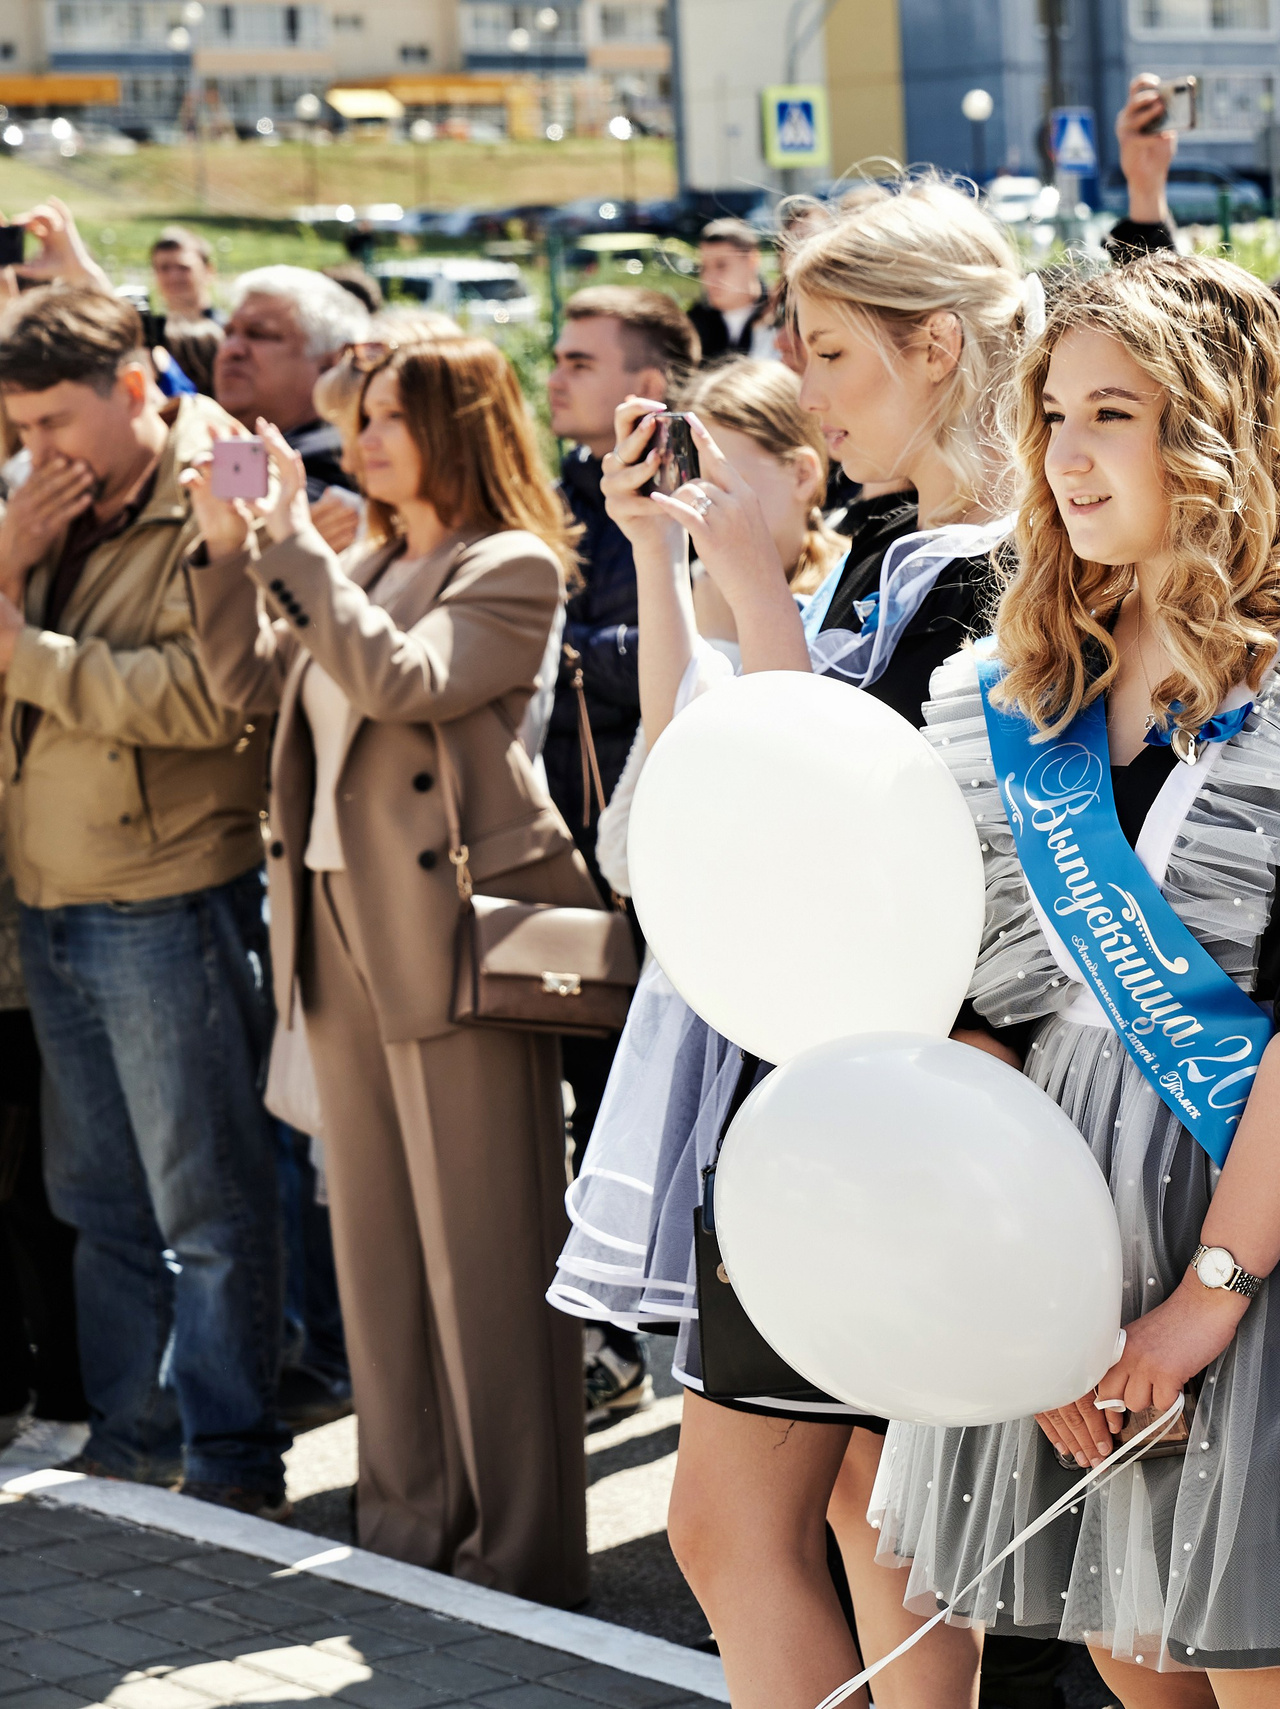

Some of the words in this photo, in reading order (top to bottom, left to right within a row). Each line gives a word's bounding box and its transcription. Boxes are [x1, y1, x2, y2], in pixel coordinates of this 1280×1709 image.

[1024, 742, 1204, 1048] Выпускница
[1177, 1035, 1259, 1124] 20
[1071, 934, 1130, 1030] Академический
[1125, 1031, 1159, 1065] лицей
[1150, 1063, 1158, 1074] г.
[1159, 1071, 1201, 1120] Томск
